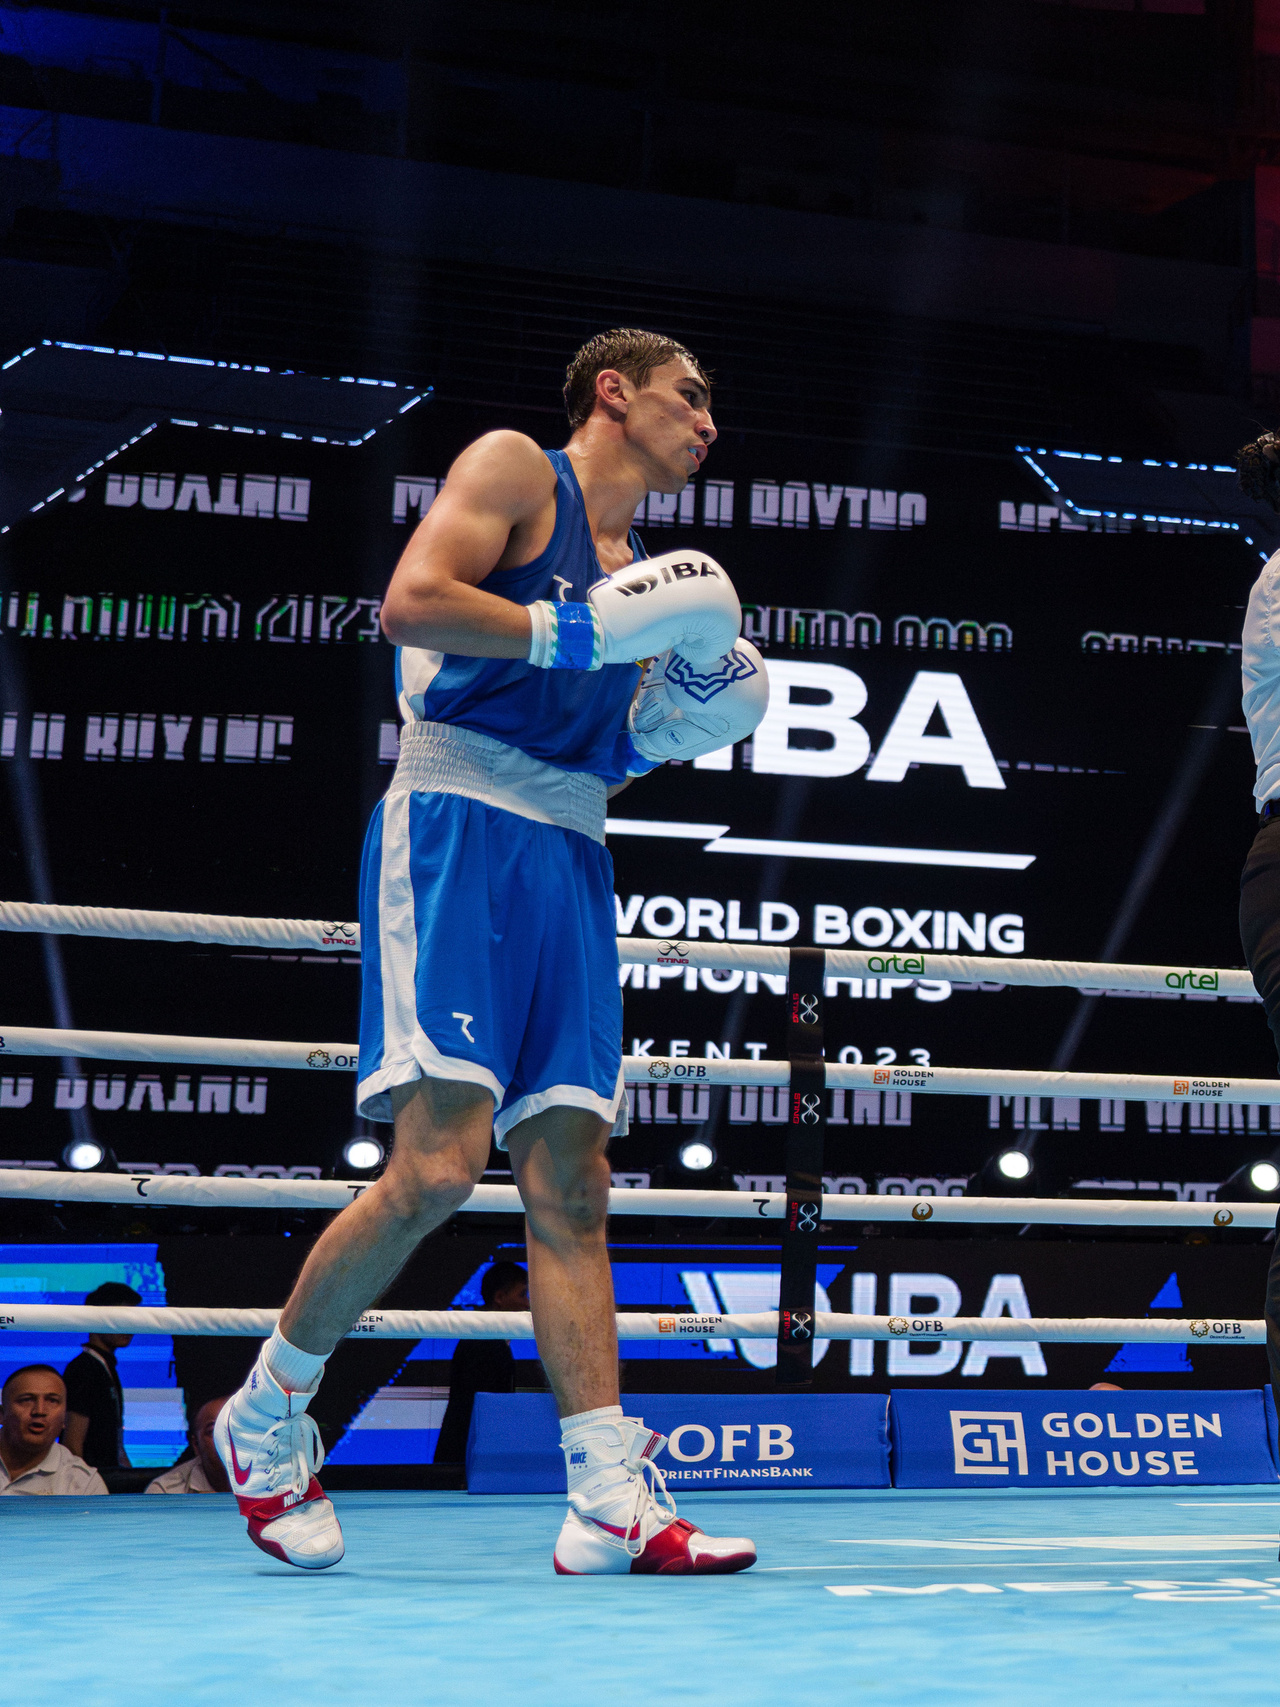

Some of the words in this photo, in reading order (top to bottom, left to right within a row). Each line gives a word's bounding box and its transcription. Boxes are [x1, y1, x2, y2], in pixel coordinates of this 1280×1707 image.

[660, 561, 723, 585] IBA
[814, 904, 1024, 953] BOXING
[322, 937, 356, 946] STING
[868, 954, 925, 975] artel
[1165, 970, 1219, 991] artel
[792, 993, 800, 1024] STING
[334, 1054, 359, 1068] OF
[674, 1064, 707, 1078] OFB
[894, 1070, 934, 1078] GOLDEN
[892, 1079, 927, 1087] HOUSE
[1191, 1089, 1223, 1097] HOUSE
[792, 1092, 801, 1125] STING
[679, 1325, 715, 1333] HOUSE
[849, 1272, 1047, 1377] IBA
[912, 1319, 944, 1332] OFB
[1212, 1322, 1242, 1335] OFB
[1042, 1412, 1223, 1438] GOLDEN
[667, 1424, 795, 1462] OFB
[570, 1451, 587, 1464] NIKE
[1046, 1450, 1200, 1477] HOUSE
